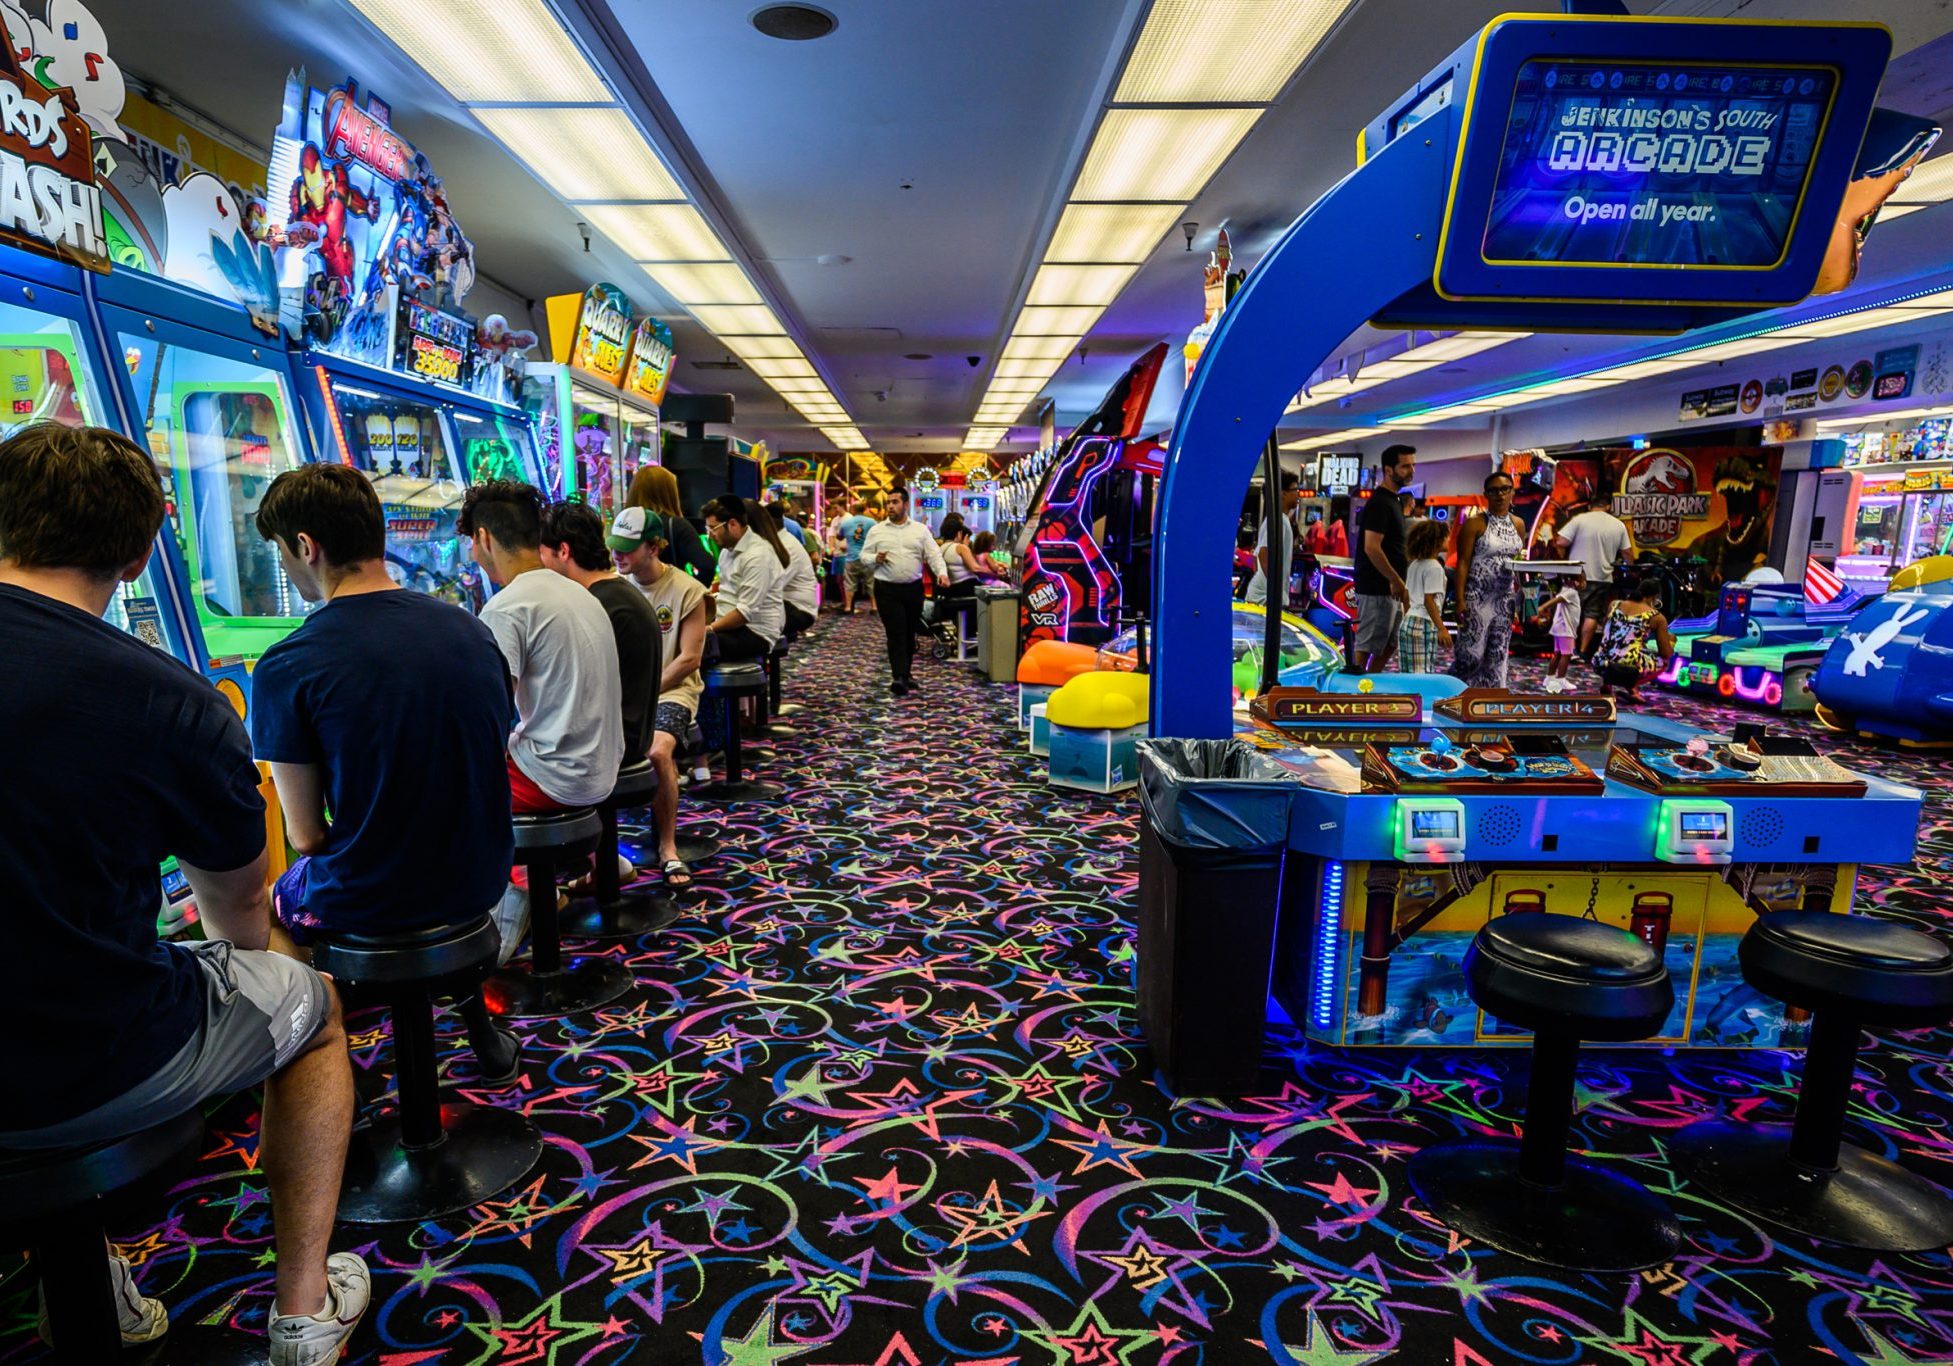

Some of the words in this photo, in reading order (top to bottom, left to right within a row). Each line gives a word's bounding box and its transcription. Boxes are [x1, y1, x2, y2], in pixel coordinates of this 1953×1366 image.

[1561, 97, 1711, 131] JENKINSON'S
[1714, 109, 1777, 131] SOUTH
[1549, 131, 1771, 175] ARCADE
[1564, 196, 1626, 225] Open
[1630, 198, 1658, 221] all
[1659, 205, 1716, 227] year.
[583, 296, 633, 346] QUARRY
[635, 331, 672, 370] QUARRY
[414, 350, 459, 380] 35000
[14, 401, 32, 413] 150
[369, 433, 393, 446] 200
[397, 433, 419, 446] 120
[1321, 467, 1359, 486] DEAD
[1667, 494, 1705, 515] PARK
[1633, 518, 1677, 534] ARCADE
[1028, 583, 1054, 606] RAW
[1031, 612, 1059, 626] VR
[1292, 703, 1378, 714] PLAYER
[1388, 703, 1399, 713] 3
[1485, 703, 1573, 714] PLAYER
[1580, 703, 1595, 714] 4
